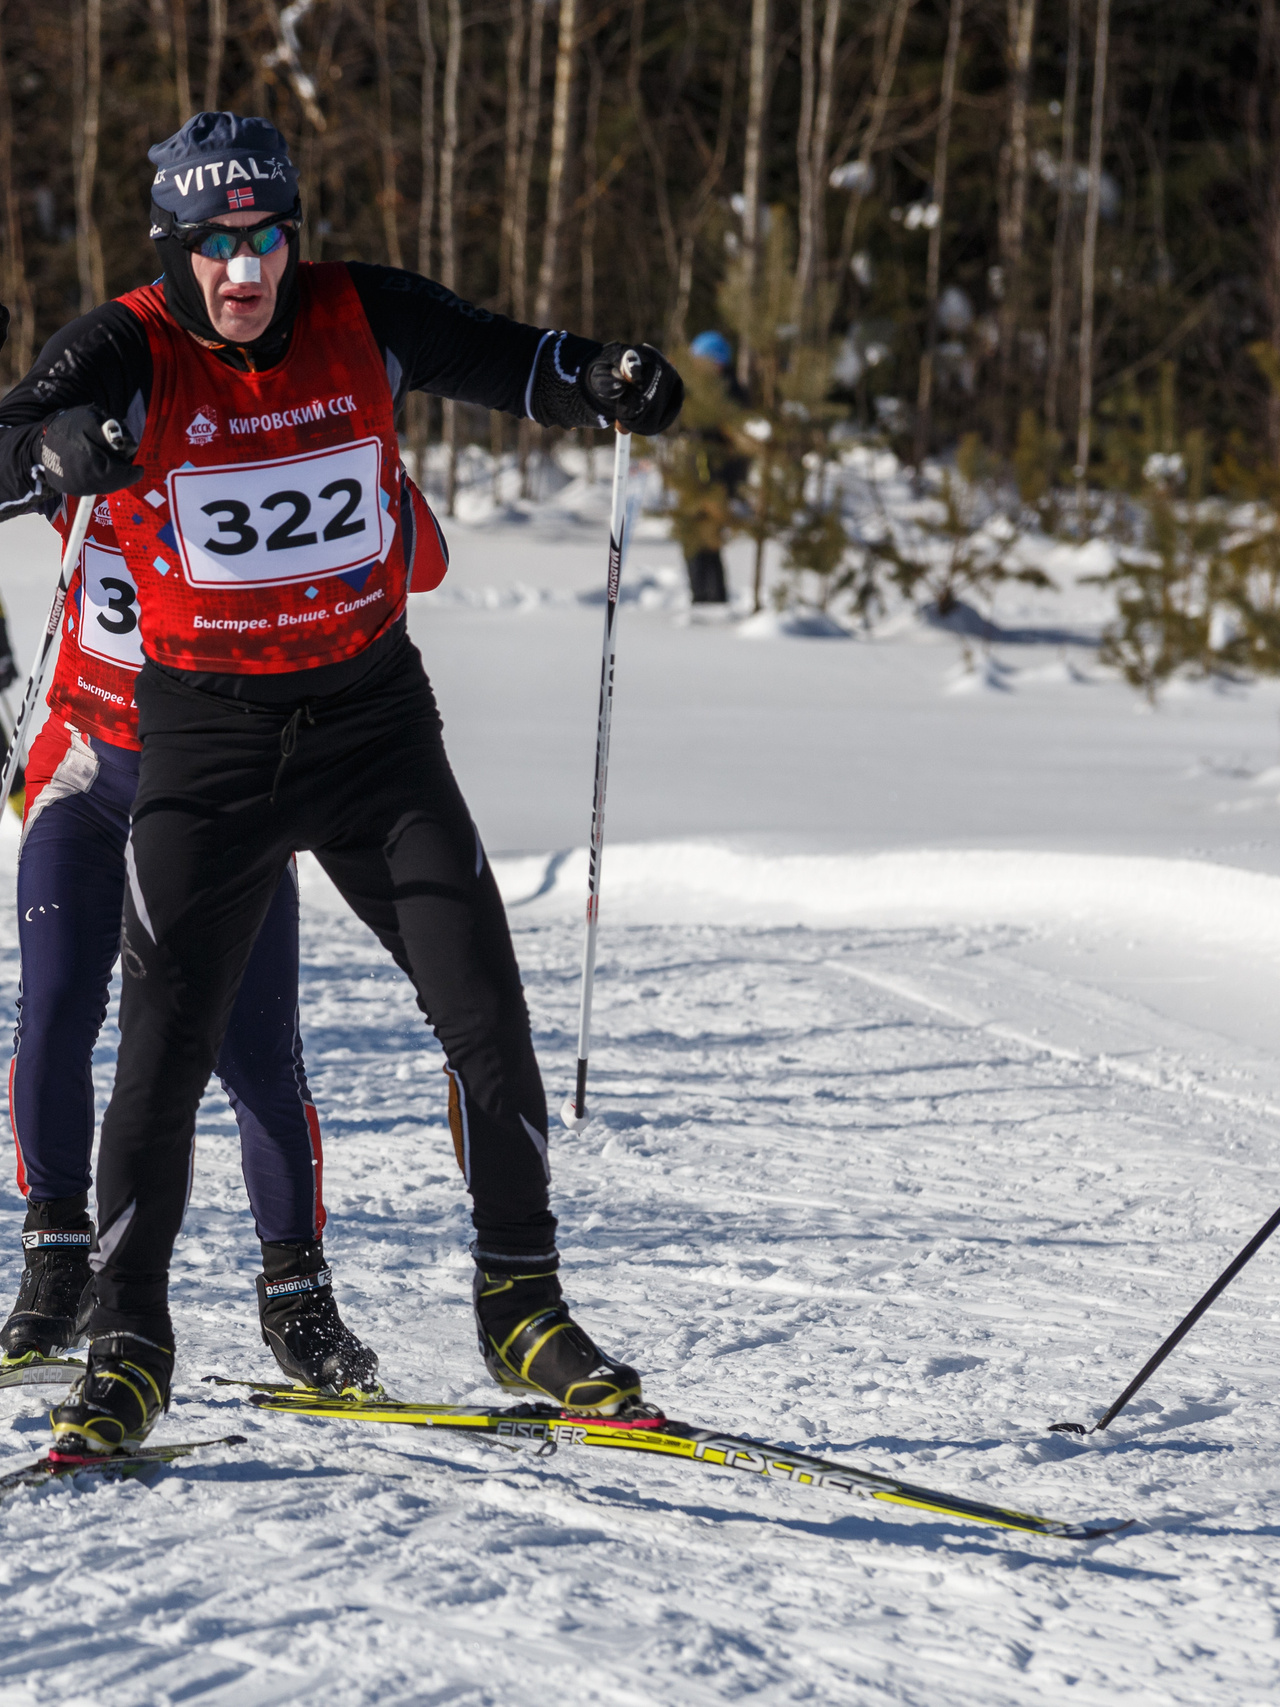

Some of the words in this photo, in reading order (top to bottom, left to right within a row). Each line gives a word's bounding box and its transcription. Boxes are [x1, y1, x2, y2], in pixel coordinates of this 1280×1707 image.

[228, 400, 326, 435] КИРОВСКИЙ
[328, 395, 358, 415] ССК
[97, 506, 110, 517] КСС
[200, 478, 366, 555] 322
[608, 548, 620, 603] MADSHUS
[46, 587, 66, 636] MADSHUS
[193, 615, 271, 633] Быстрее.
[277, 609, 330, 627] Выше.
[334, 588, 385, 615] Сильнее.
[77, 675, 126, 706] Быстрее.
[22, 1366, 63, 1384] FISCHER
[496, 1421, 588, 1445] FISCHER
[694, 1439, 900, 1499] FISCHER
